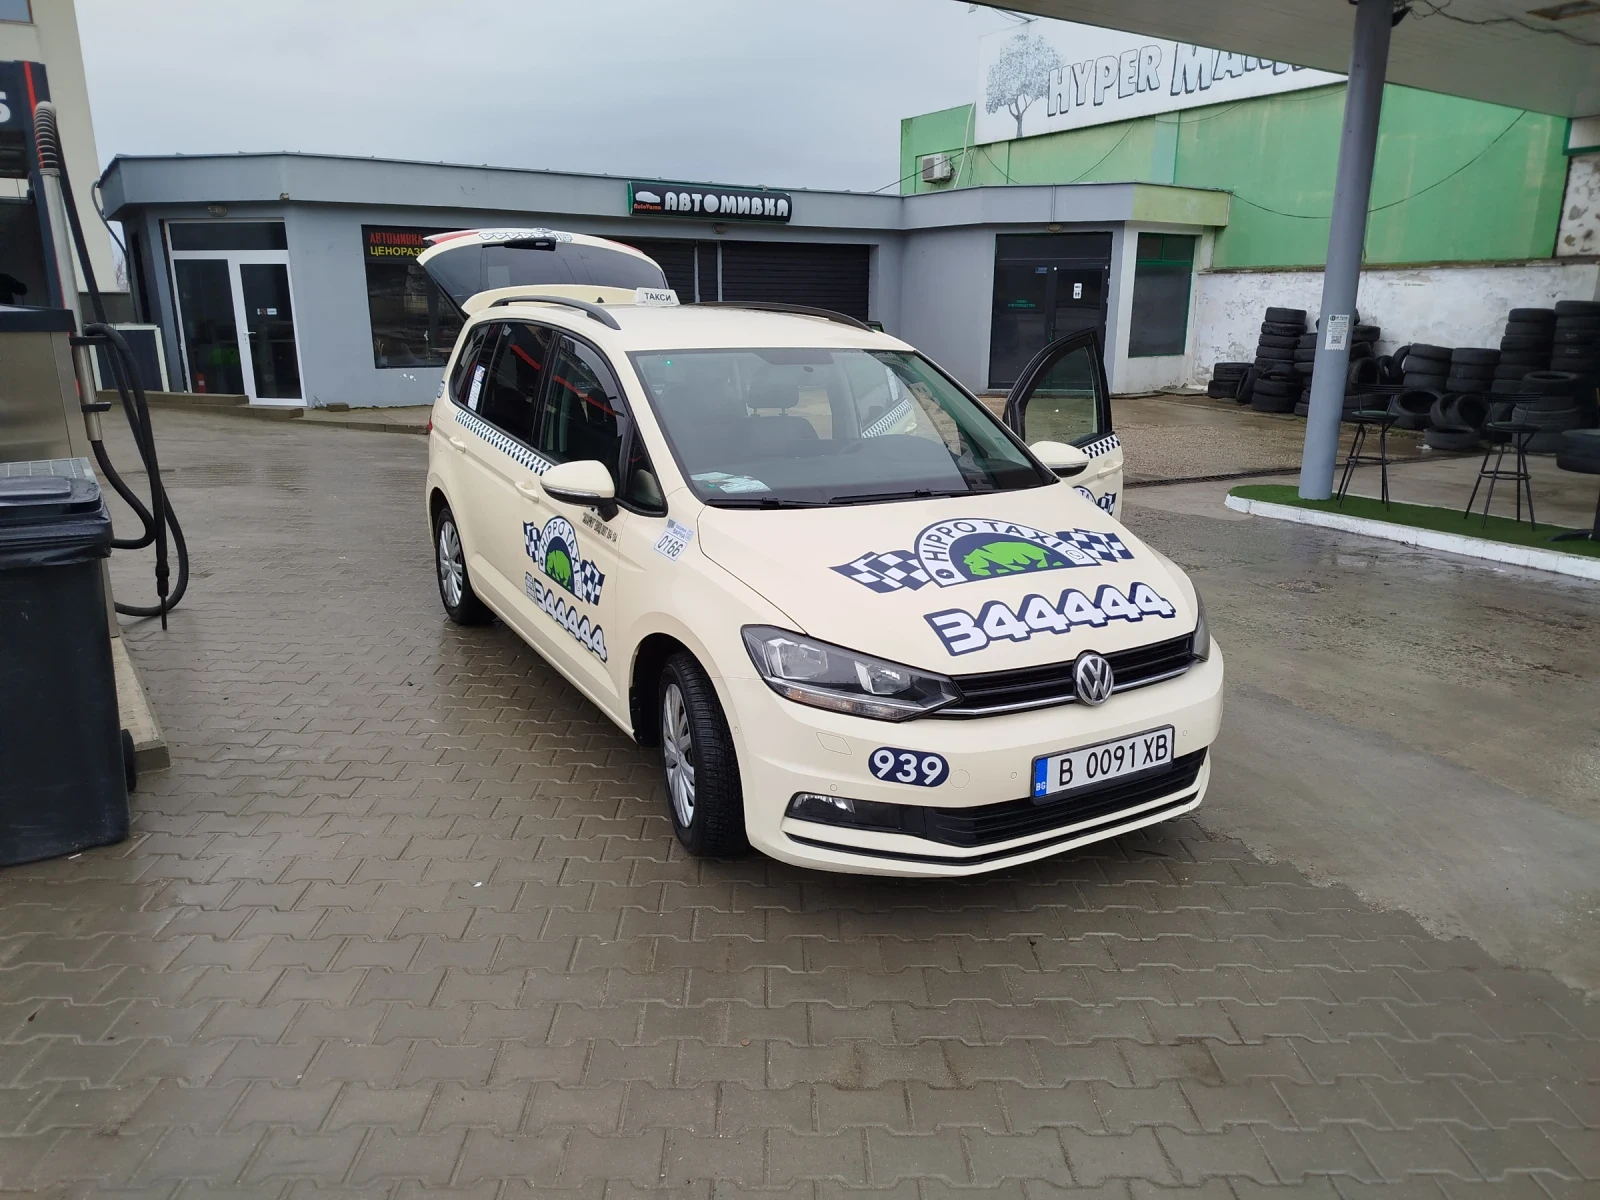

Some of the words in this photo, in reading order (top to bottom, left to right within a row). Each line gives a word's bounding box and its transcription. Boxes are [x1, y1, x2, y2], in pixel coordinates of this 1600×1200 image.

[1047, 44, 1163, 117] HYPER
[664, 191, 789, 217] АВТОМИВКА
[369, 232, 424, 245] АВТОМИВКА
[644, 292, 671, 302] ТАКСИ
[540, 521, 566, 553] HIPPO
[565, 528, 580, 575] TAXI
[657, 535, 684, 557] 0166
[924, 521, 978, 563] HIPPO
[982, 521, 1064, 548] TAXI
[534, 578, 607, 663] 344444
[925, 582, 1176, 656] 344444
[873, 749, 943, 785] 939
[1035, 782, 1047, 791] BG
[1059, 758, 1073, 786] B
[1086, 741, 1136, 779] 0091
[1142, 734, 1168, 765] XB
